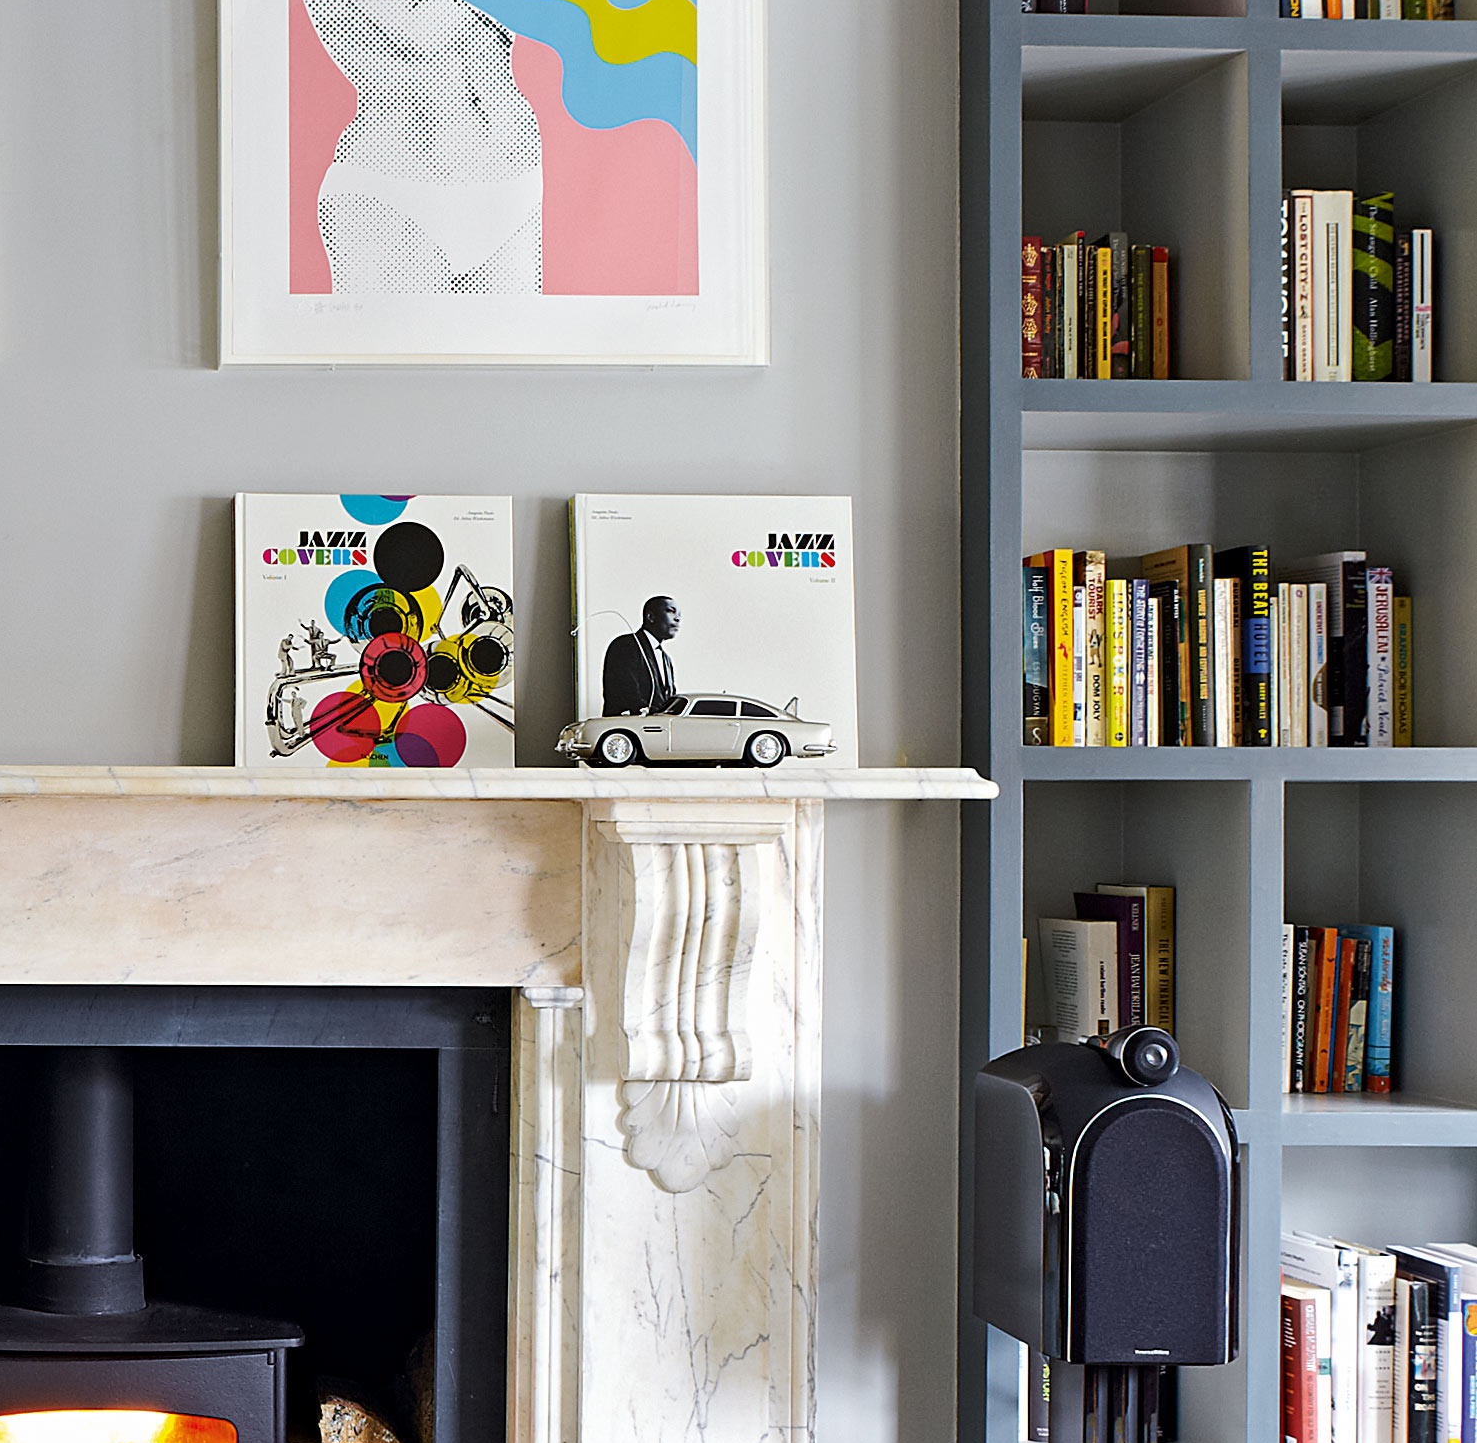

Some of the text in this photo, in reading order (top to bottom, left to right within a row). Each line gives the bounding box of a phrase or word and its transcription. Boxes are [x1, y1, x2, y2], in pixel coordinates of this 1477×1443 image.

[1300, 214, 1308, 284] LOST CITY
[1368, 205, 1378, 290] The Stranger's Child
[1368, 298, 1378, 372] Alan Hollinghurst
[263, 548, 367, 565] COVERS
[298, 531, 367, 547] JAZZ
[731, 551, 835, 567] COVERS
[766, 534, 835, 550] JAZZ
[1028, 576, 1044, 649] Half Blood Blues
[1088, 578, 1096, 620] TOURIST
[1253, 550, 1268, 666] THE BEAT HOTEL
[1376, 586, 1389, 654] JERUSALEM
[1399, 623, 1408, 733] BRANDO BOB THOMAS
[1131, 903, 1139, 931] KELLNER
[1129, 953, 1140, 1025] JEAN BAUDRILLAR
[1159, 939, 1169, 1024] THE NEW FINANCIAL
[1298, 941, 1307, 995] SUSAN SONTAG
[1296, 1000, 1305, 1066] ON PHOTOGRAPHY
